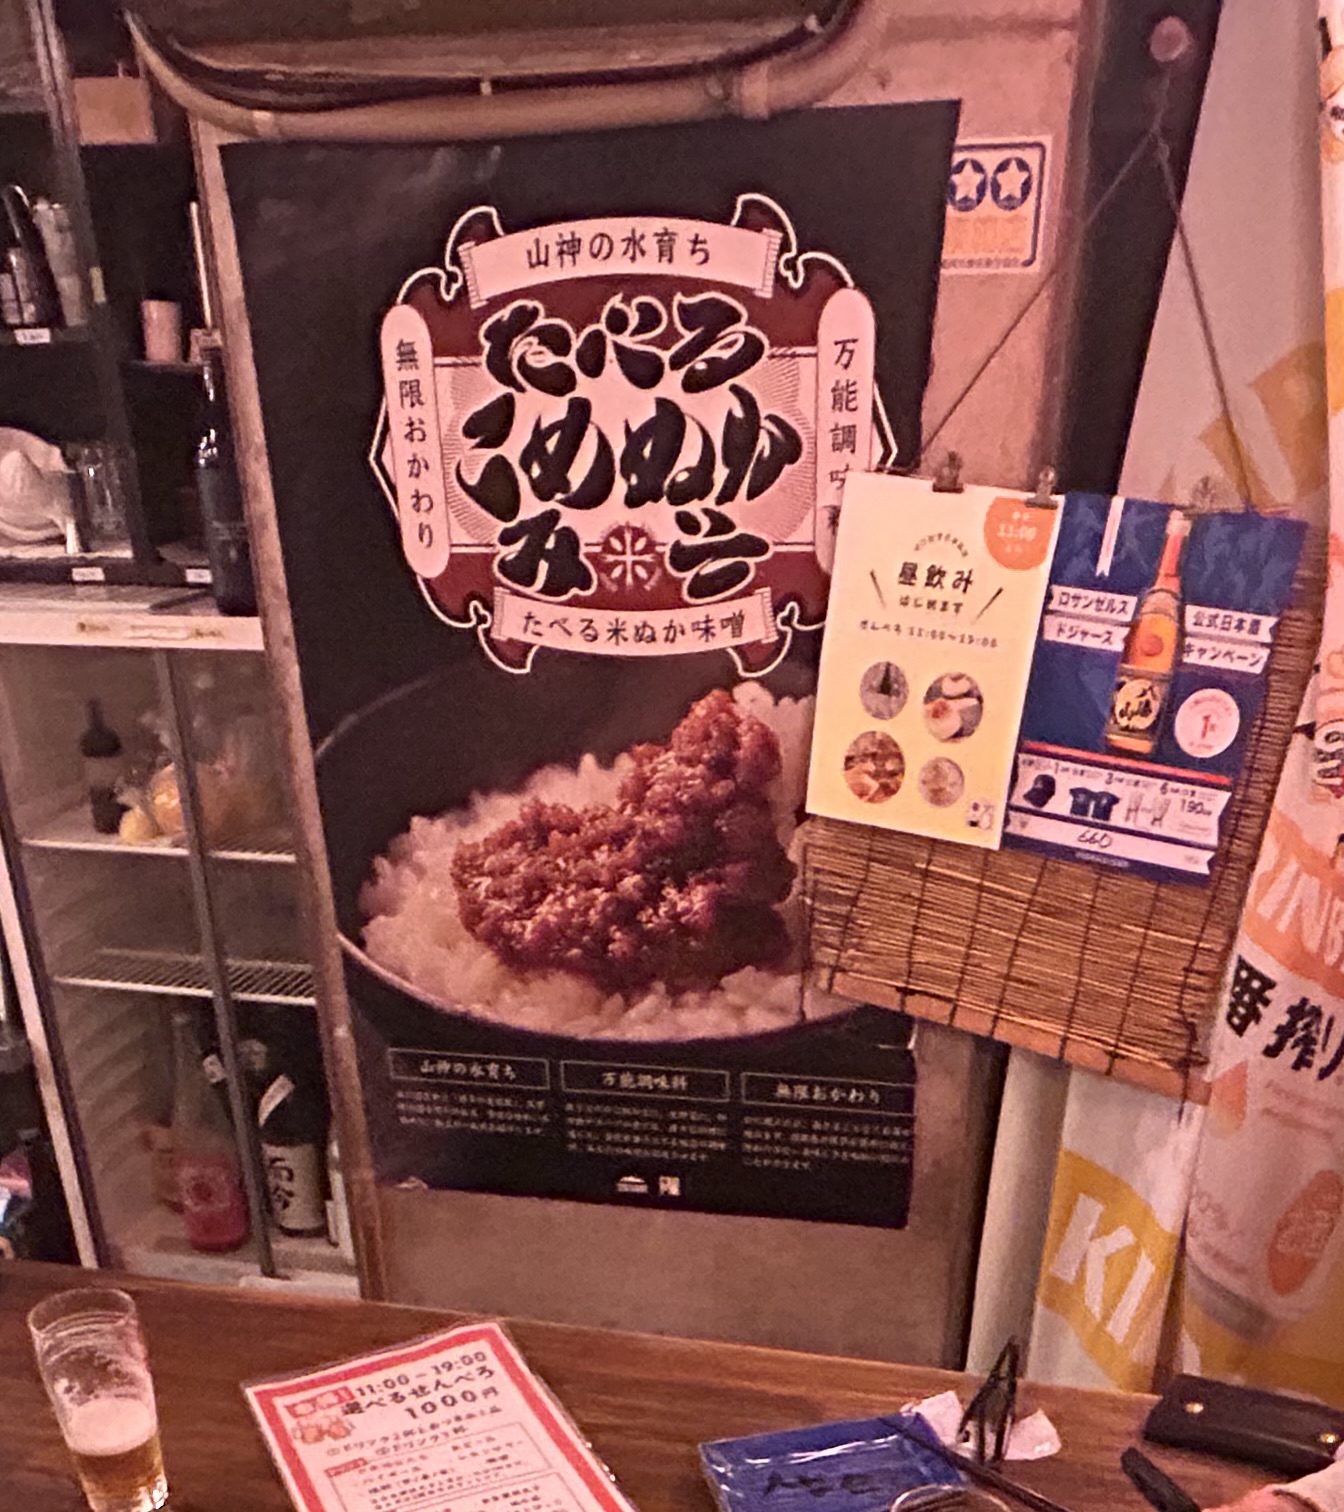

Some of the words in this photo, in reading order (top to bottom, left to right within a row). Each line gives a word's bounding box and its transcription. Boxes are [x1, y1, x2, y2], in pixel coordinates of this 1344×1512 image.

[526, 227, 711, 269] 山神の水育ち
[483, 294, 768, 396] たべる
[395, 338, 435, 549] 無限おかわり
[456, 383, 803, 523] こめぬか
[898, 561, 974, 594] 昼飲み
[1058, 590, 1129, 616] ロサンゼルス
[521, 610, 747, 645] たべる米ぬか味噌
[1057, 622, 1113, 645] ドジャース
[1184, 641, 1263, 667] キャンペーン
[1077, 829, 1113, 849] 660
[1049, 1192, 1156, 1345] KI
[341, 1364, 495, 1416] 選べるせんべろ
[355, 1373, 411, 1397] 11:00
[431, 1351, 487, 1375] 19:00
[405, 1385, 499, 1420] 1000円
